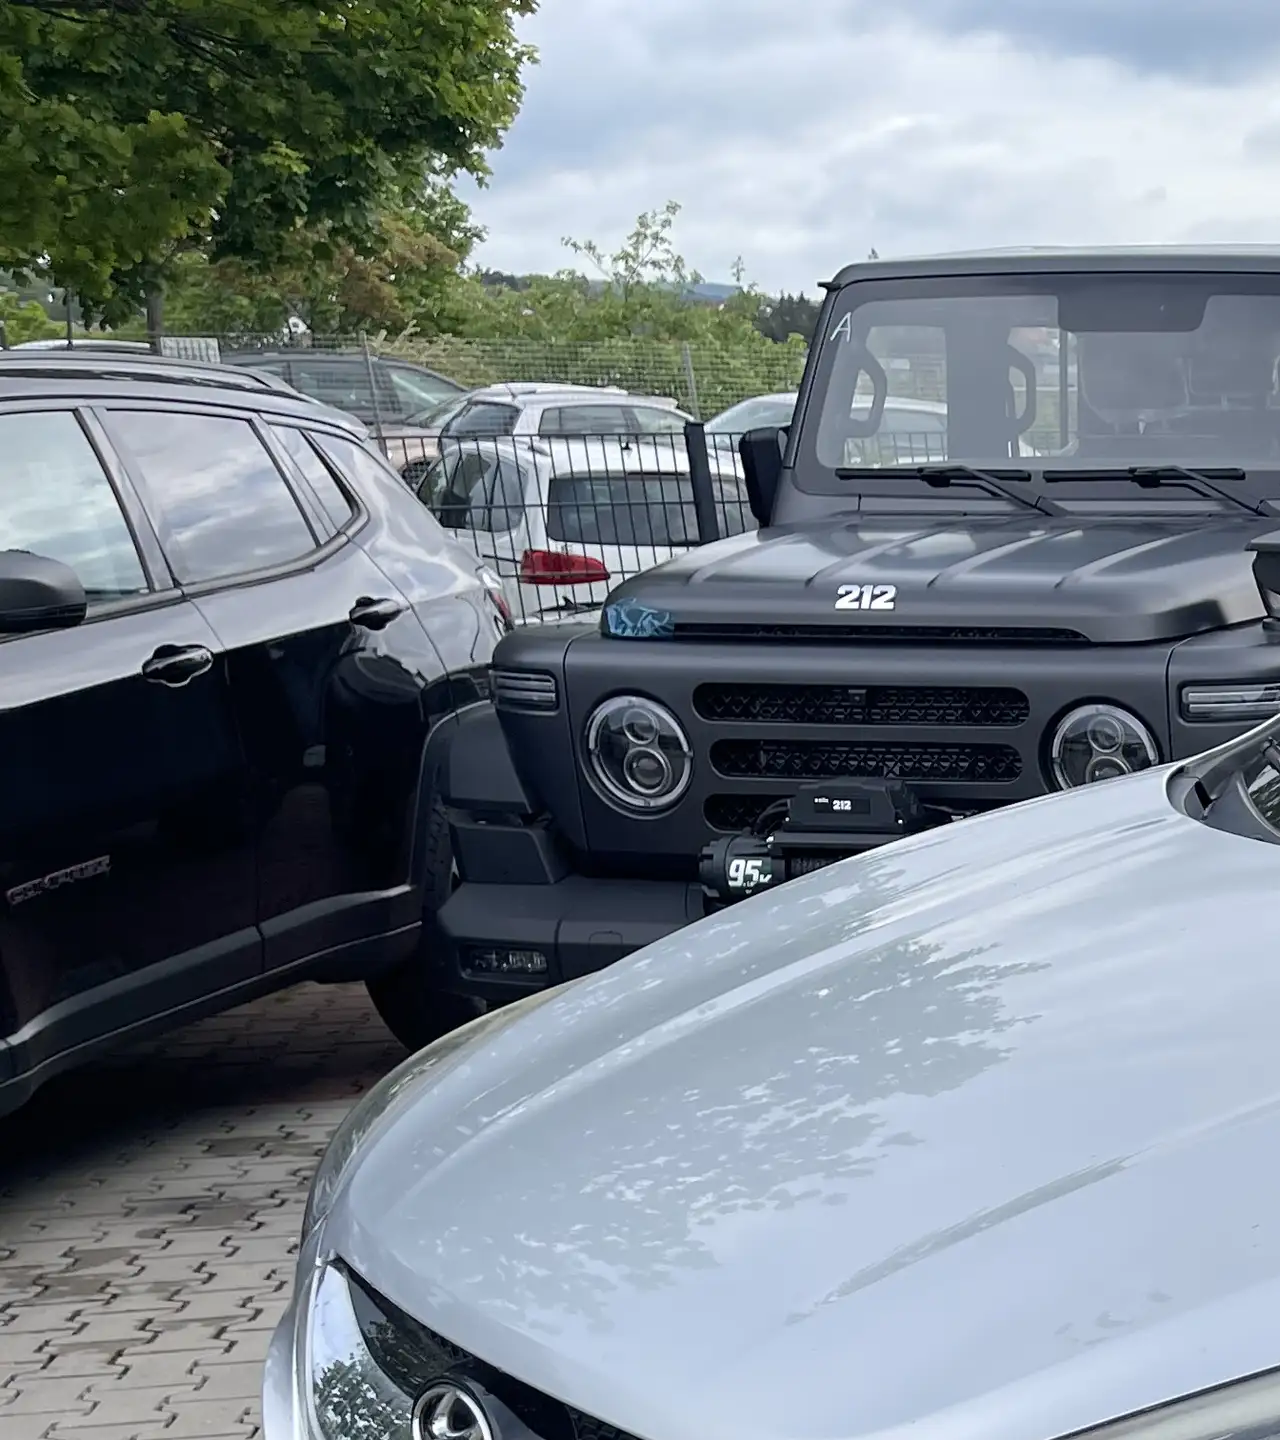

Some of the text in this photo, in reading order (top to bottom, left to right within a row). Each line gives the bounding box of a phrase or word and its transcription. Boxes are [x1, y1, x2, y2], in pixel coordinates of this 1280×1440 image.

[830, 311, 852, 342] A
[835, 584, 896, 610] 212
[832, 799, 852, 811] 212
